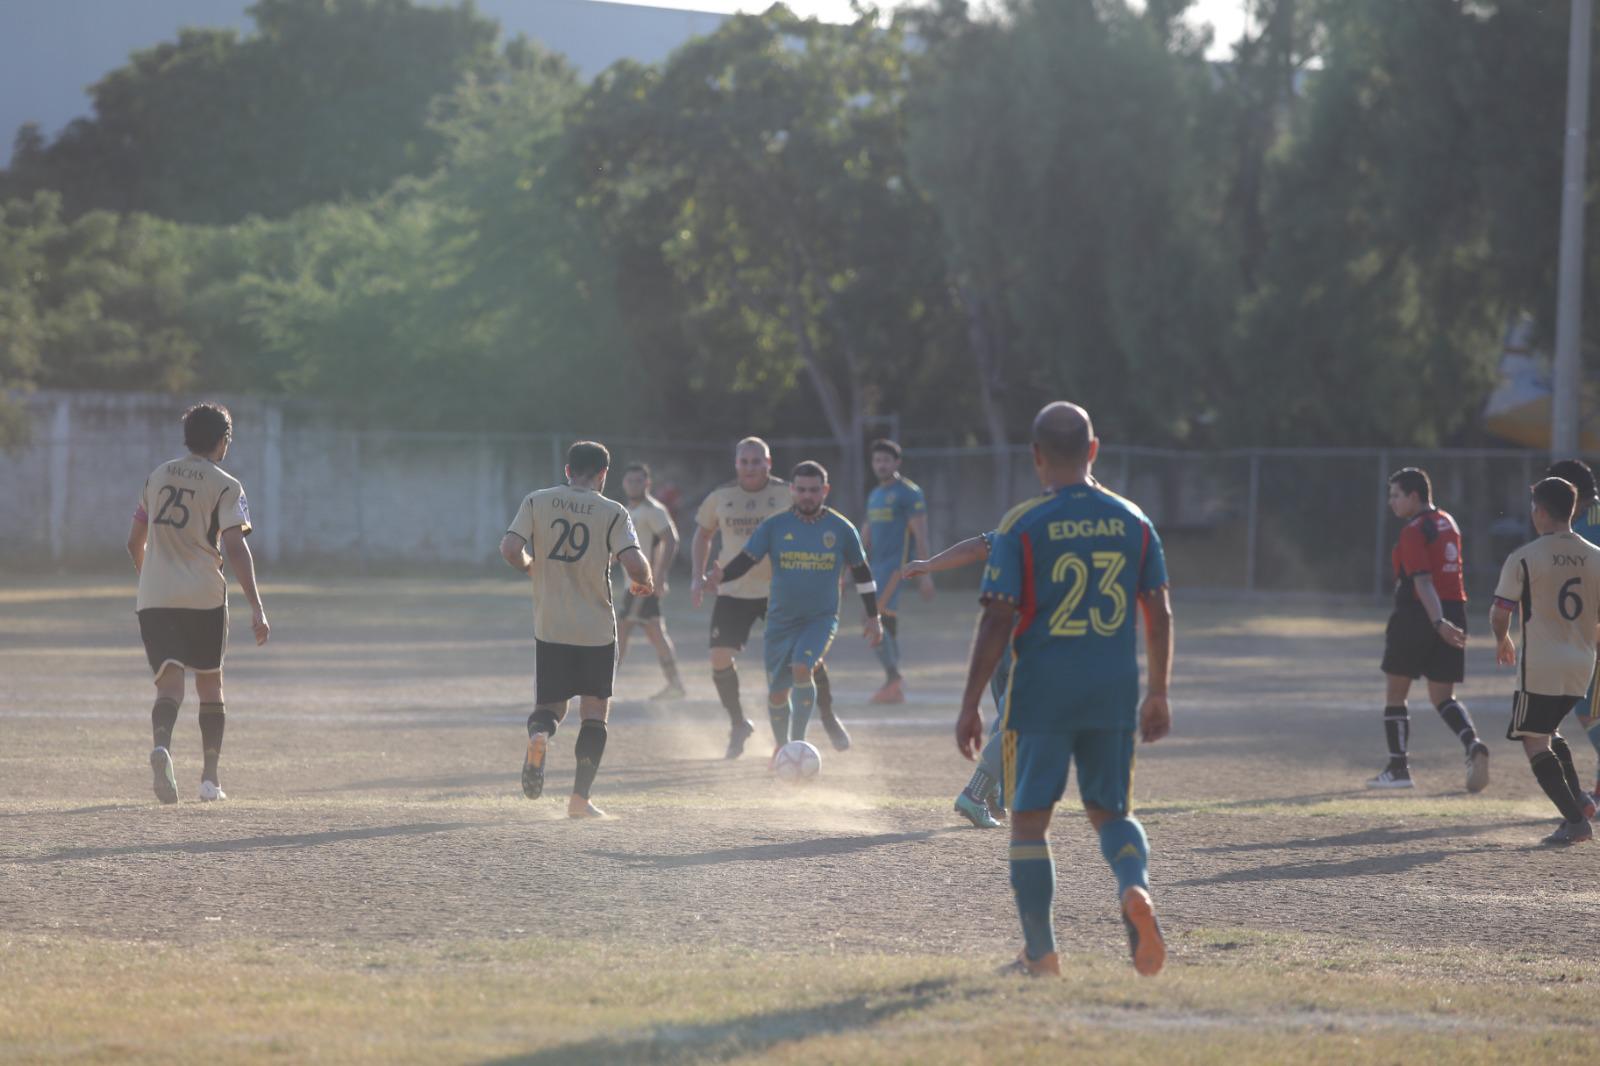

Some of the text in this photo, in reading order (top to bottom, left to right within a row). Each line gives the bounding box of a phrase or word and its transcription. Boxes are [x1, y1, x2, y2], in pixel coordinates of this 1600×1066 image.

[166, 464, 204, 481] MACIAS
[153, 485, 195, 528] 25
[552, 498, 594, 515] OVALLE
[548, 518, 590, 563] 29
[1048, 518, 1125, 540] EDGAR
[1553, 553, 1588, 567] JONY
[1049, 552, 1127, 636] 23
[1558, 577, 1583, 620] 6
